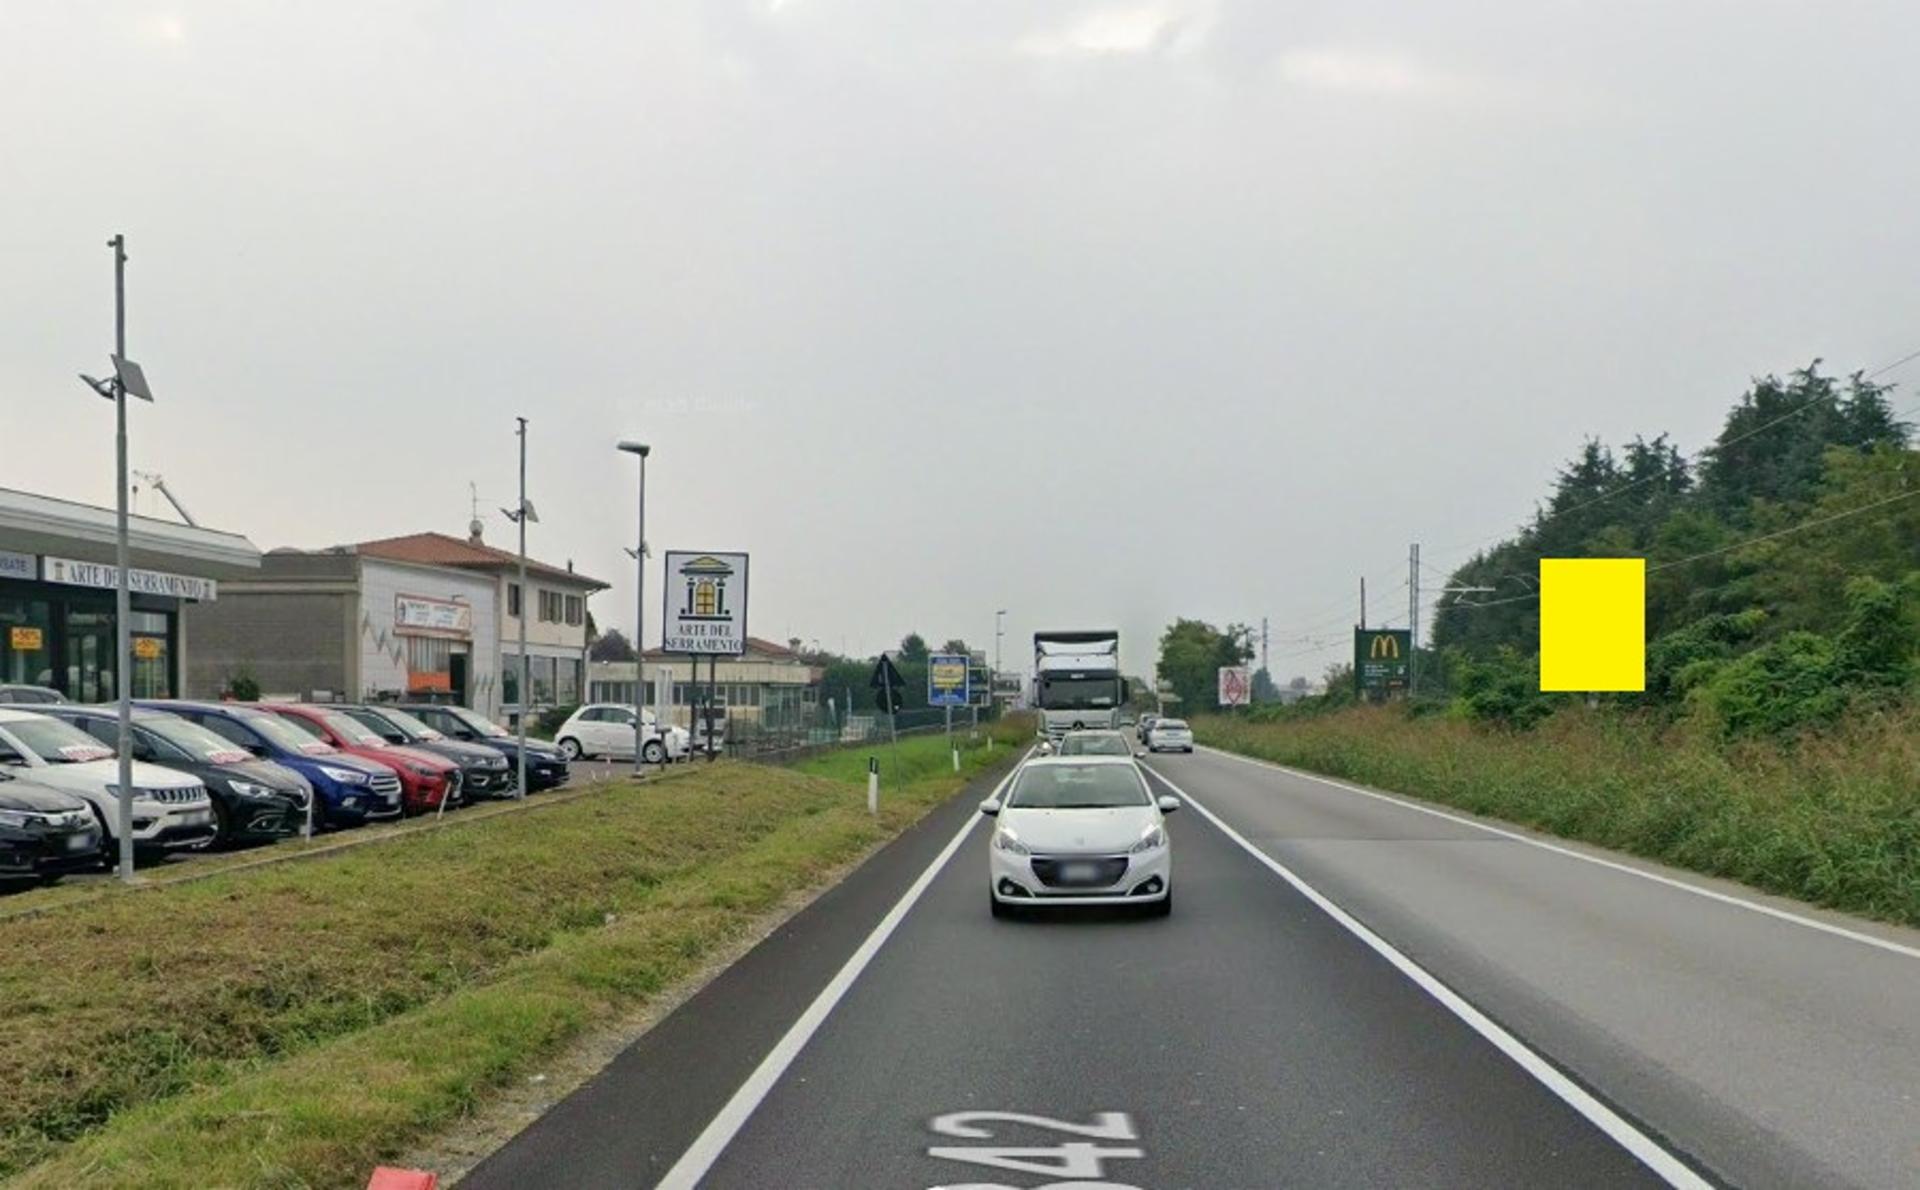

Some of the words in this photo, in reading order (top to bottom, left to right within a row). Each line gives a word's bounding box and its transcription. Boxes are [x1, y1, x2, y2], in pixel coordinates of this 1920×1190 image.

[69, 564, 101, 586] ARTE
[129, 571, 202, 598] SERRAMENTO
[679, 624, 706, 636] ARTE
[710, 624, 731, 636] DEL
[666, 637, 743, 650] SERRAMENTO
